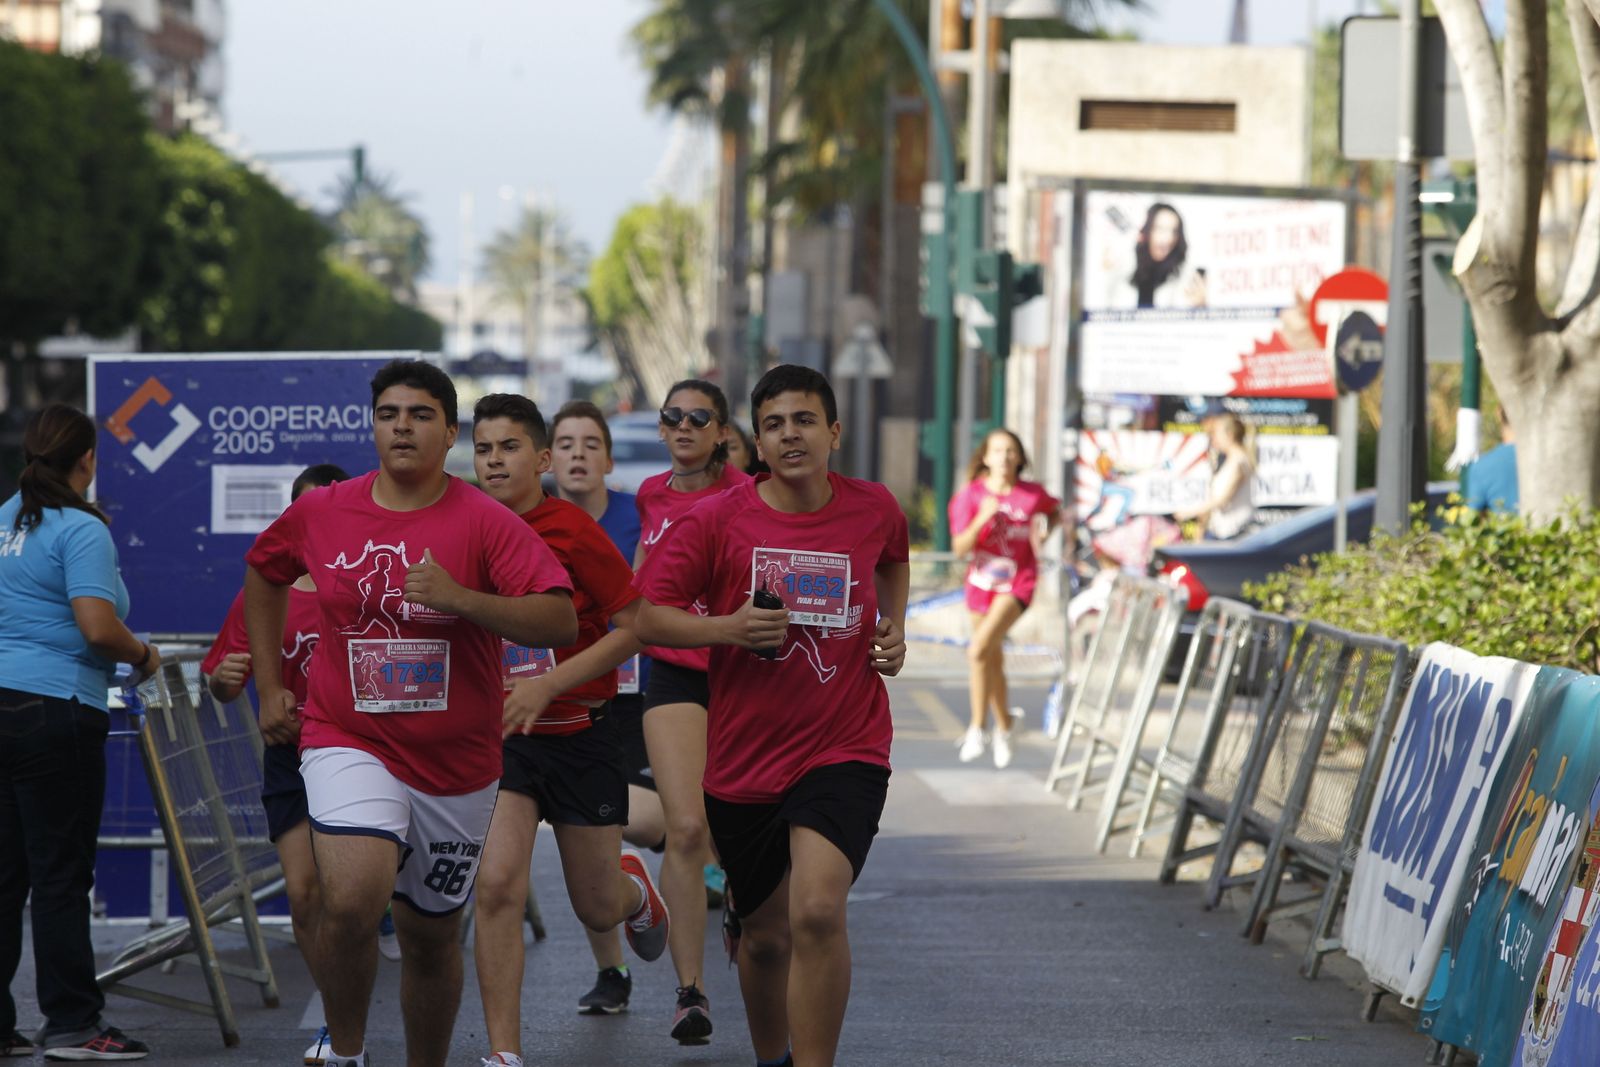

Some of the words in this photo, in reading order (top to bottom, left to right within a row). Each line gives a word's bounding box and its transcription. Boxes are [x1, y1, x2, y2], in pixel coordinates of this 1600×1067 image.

[208, 405, 374, 431] COOPERACI
[212, 431, 275, 454] 2005
[783, 573, 845, 598] 1652
[380, 661, 445, 684] 1792
[404, 685, 419, 693] LUIS
[429, 841, 460, 856] NEW
[423, 857, 472, 896] 86
